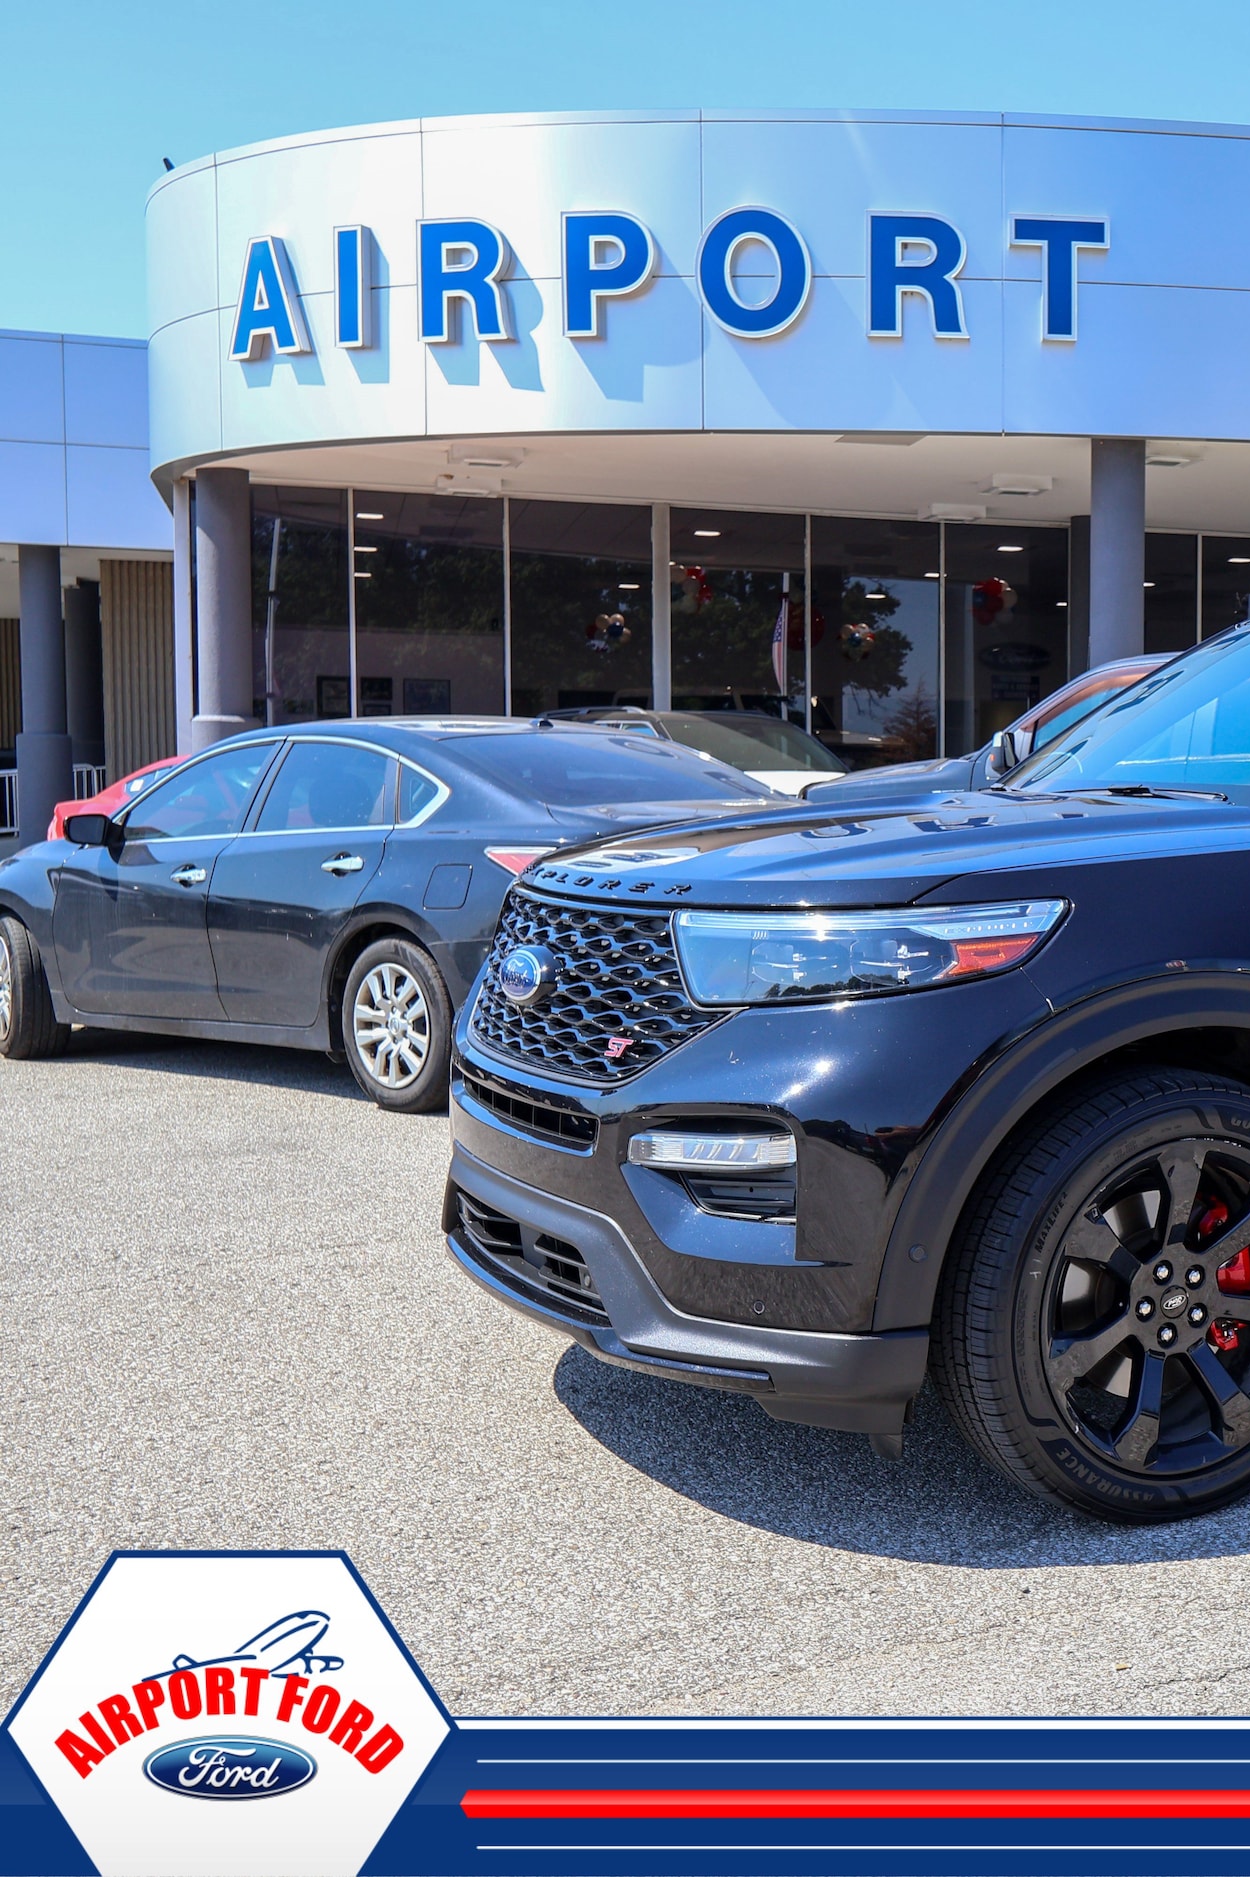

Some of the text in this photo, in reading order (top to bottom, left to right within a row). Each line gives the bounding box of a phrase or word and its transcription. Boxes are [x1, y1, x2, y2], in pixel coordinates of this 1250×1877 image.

[227, 205, 1110, 362] AIRPORT
[604, 1037, 633, 1058] ST
[1055, 1447, 1156, 1501] ASSURANCE
